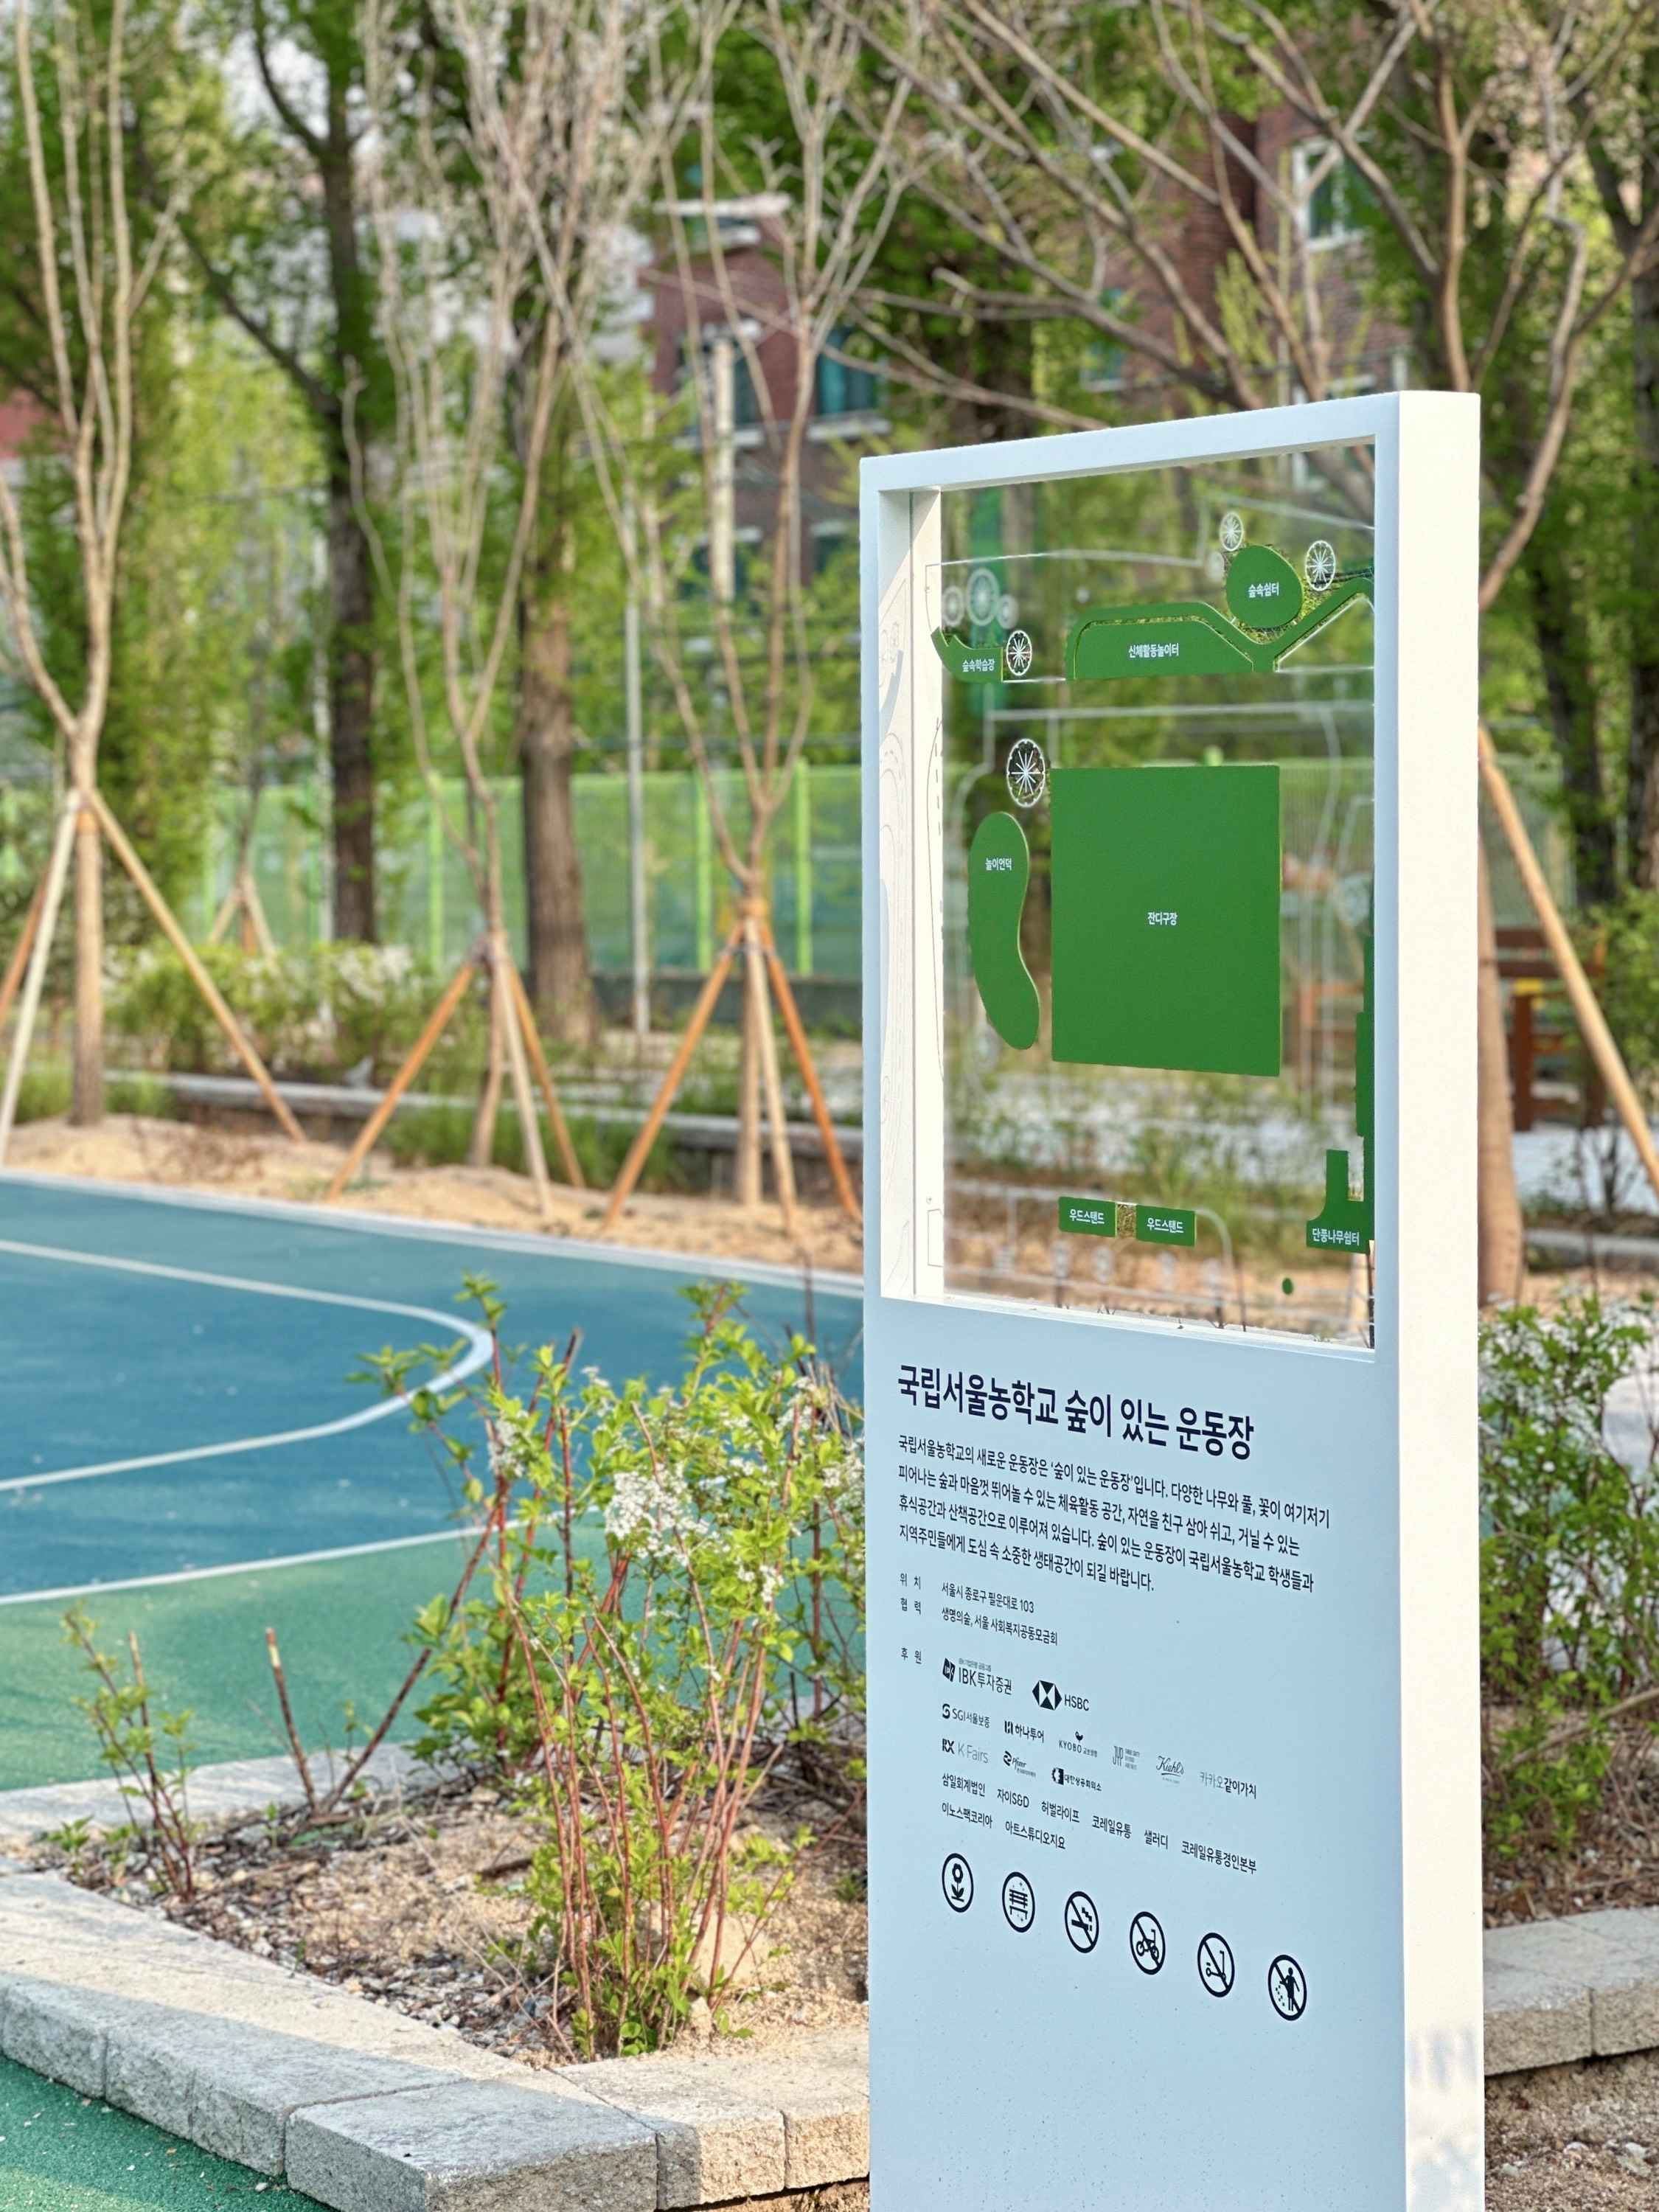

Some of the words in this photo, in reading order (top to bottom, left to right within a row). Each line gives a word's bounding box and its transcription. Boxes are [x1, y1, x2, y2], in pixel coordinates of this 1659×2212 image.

[1248, 582, 1280, 598] 숲속쉼터
[1128, 643, 1180, 658] 신체활동놀이터
[985, 858, 1012, 871] 놀이언덕
[1147, 911, 1178, 925] 잔디구장
[1312, 1228, 1360, 1246] 단풍나무쉼터
[898, 1365, 1058, 1425] 국립서울농학교
[1065, 1390, 1111, 1437] 숲이
[1121, 1399, 1169, 1447] 있는
[1176, 1408, 1254, 1460] 운동장
[899, 1435, 973, 1464] 국립서울농학교의
[977, 1449, 1006, 1470] 새로운
[1009, 1454, 1048, 1477] 운동장은
[1077, 1466, 1096, 1486] 있는
[1172, 1483, 1203, 1505] 다양한
[1206, 1489, 1239, 1512] 나무와
[1242, 1495, 1255, 1516] 풀,
[1259, 1498, 1280, 1520] 꽃이
[1284, 1503, 1329, 1528] 여기저기
[899, 1465, 936, 1487] 피어나는
[939, 1472, 958, 1491] 숲과
[961, 1476, 989, 1497] 마음껏
[992, 1481, 1020, 1503] 뛰어놀
[1023, 1488, 1033, 1505] 수
[1037, 1490, 1056, 1509] 있는
[1059, 1494, 1099, 1517] 체육활동
[1102, 1502, 1124, 1524] 공간,
[1128, 1507, 1159, 1529] 자연을
[1162, 1512, 1183, 1534] 친구
[1186, 1518, 1208, 1538] 삼아
[1210, 1522, 1234, 1545] 쉬고,
[1239, 1528, 1259, 1548] 거닐
[1263, 1532, 1274, 1551] 수
[1278, 1535, 1300, 1557] 있는
[899, 1495, 946, 1519] 휴식공간과
[949, 1504, 1006, 1529] 산책공간으로
[1009, 1516, 1048, 1540] 이루어져
[1051, 1523, 1094, 1548] 있습니다.
[1097, 1532, 1117, 1554] 숲이
[1121, 1537, 1141, 1557] 있는
[1144, 1542, 1185, 1567] 운동장이
[1189, 1551, 1265, 1581] 국립서울농학교
[1268, 1565, 1314, 1593] 학생들과
[900, 1525, 965, 1553] 지역주민들에게
[968, 1538, 987, 1557] 도심
[990, 1543, 999, 1560] 속
[1002, 1545, 1032, 1566] 소중한
[1034, 1551, 1083, 1578] 생태공간이
[1087, 1562, 1106, 1582] 되길
[1110, 1567, 1154, 1591] 바랍니다.
[942, 1582, 963, 1599] 서울시
[964, 1587, 987, 1604] 종로구
[988, 1592, 1018, 1610] 필운대로
[1020, 1599, 1034, 1613] 103
[975, 1615, 990, 1630] 서울
[991, 1616, 1057, 1646] 사회복지공동모금회
[959, 1667, 1012, 1695] IBK투자증권
[1064, 1694, 1090, 1711] HSBC
[952, 1708, 990, 1728] SGI서울보증
[1015, 1724, 1045, 1743] 하나투어
[967, 1745, 989, 1763] Fairs
[1059, 1740, 1082, 1753] KYOBO
[942, 1773, 986, 1798] 삼일회계법인
[997, 1788, 1030, 1807] 자이S&D
[1041, 1801, 1080, 1823] 허벌라이프
[1092, 1815, 1133, 1840] 코레일유통
[1144, 1829, 1169, 1849] 샐러디
[1181, 1841, 1256, 1874] 코레일유통경인본부
[1005, 1821, 1065, 1849] 아트스튜디오지요
